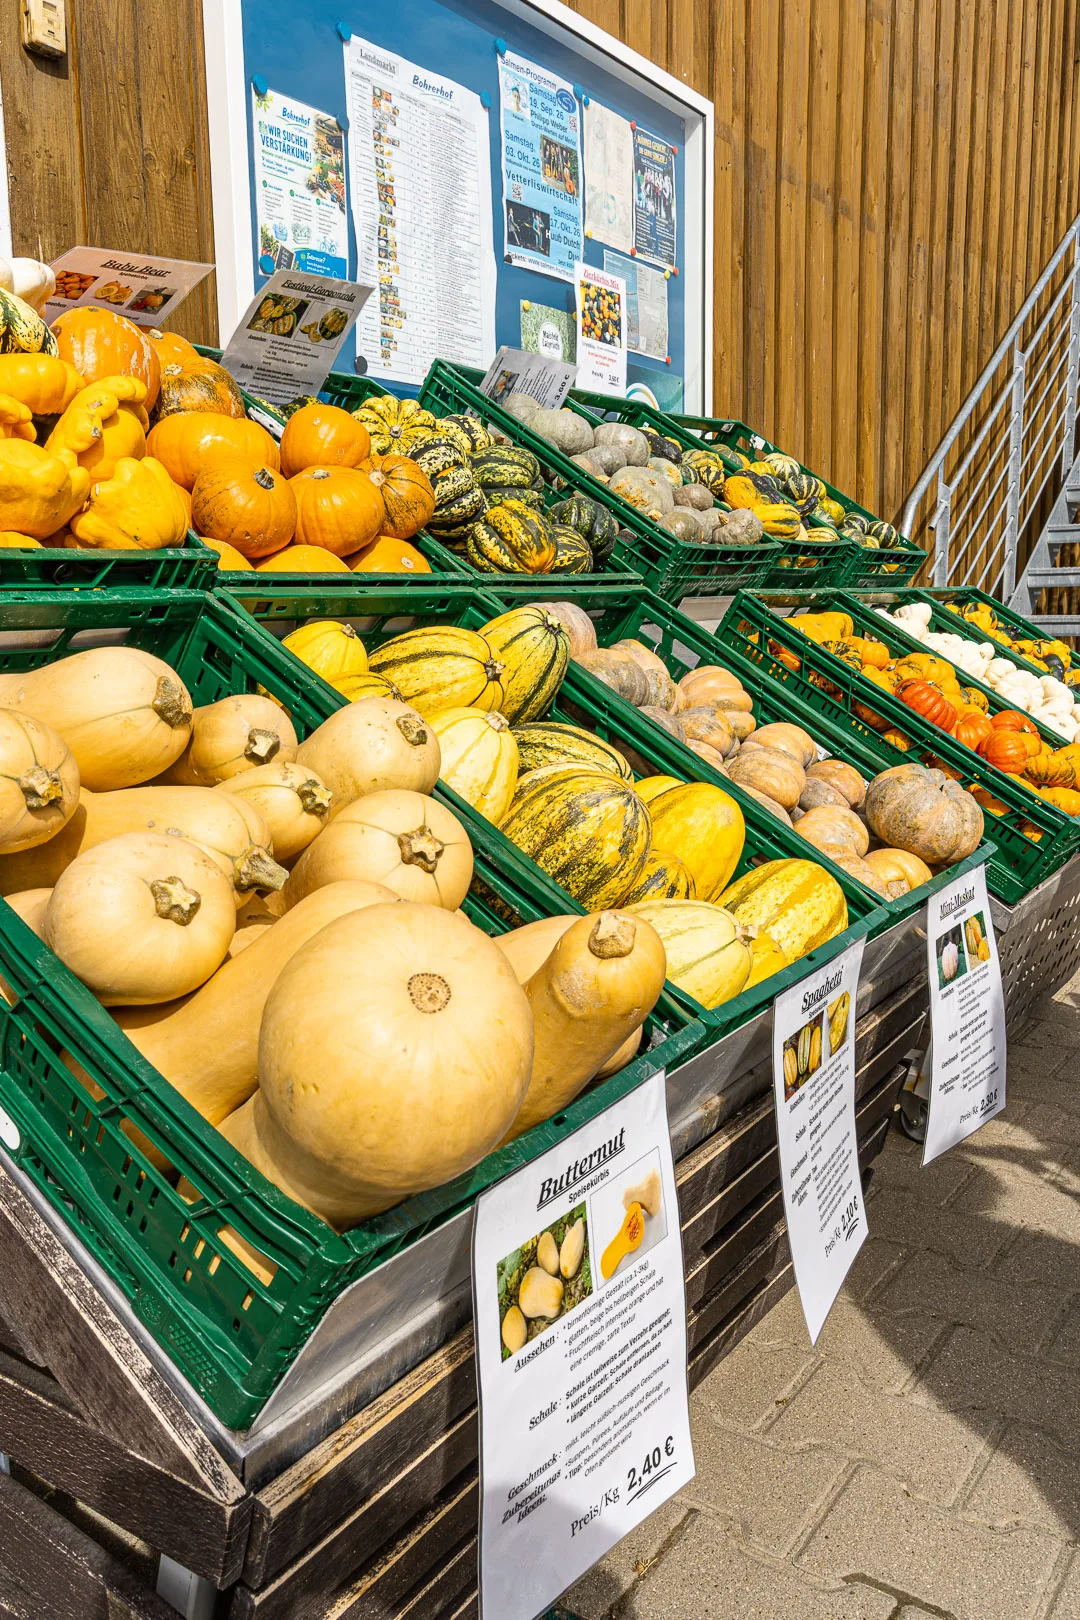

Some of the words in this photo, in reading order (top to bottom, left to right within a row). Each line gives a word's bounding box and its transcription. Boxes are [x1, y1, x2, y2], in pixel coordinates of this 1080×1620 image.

[360, 48, 396, 74] Landmarkt
[501, 56, 556, 91] Salmen-Programm
[412, 75, 453, 100] Bohrerhof
[282, 108, 310, 126] Bohrerhof
[530, 96, 539, 108] 19.
[541, 102, 554, 116] Sep.
[556, 110, 564, 120] 26
[530, 110, 550, 125] Philipp
[551, 118, 568, 133] Weber
[261, 134, 312, 163] VERSTÄRKUNG!
[268, 124, 281, 138] WIR
[283, 130, 308, 148] SUCHEN
[505, 130, 535, 152] Samstag,
[505, 146, 516, 158] 03.
[517, 149, 530, 164] Okt.
[532, 156, 540, 168] 26
[506, 169, 578, 206] Vetterliswirtschaft
[550, 218, 559, 229] 17.
[561, 222, 572, 234] Okt.
[574, 227, 580, 237] 26
[553, 206, 579, 226] Samstag,
[546, 229, 562, 242] Huub
[564, 236, 580, 248] Dutch
[100, 259, 138, 273] Baby
[139, 265, 171, 277] Bear
[281, 280, 356, 302] Festival-Gorgonzola
[610, 280, 620, 291] Mix
[555, 382, 566, 400] 3,60
[940, 885, 975, 919] Mini-Muskat
[802, 965, 843, 1012] Spaghetti
[980, 1092, 993, 1112] 2,30
[994, 1088, 998, 1100] €
[538, 1127, 625, 1206] Butternut
[569, 1169, 610, 1203] Speisekürbis
[841, 1202, 854, 1232] 2,10
[854, 1196, 858, 1210] €
[568, 1296, 605, 1330] birnenförmige
[605, 1280, 624, 1299] Gestalt
[568, 1324, 589, 1345] glatten,
[590, 1311, 604, 1327] beige
[614, 1284, 639, 1306] hellbeigen
[640, 1269, 656, 1287] Schale
[569, 1325, 604, 1358] Fruchtfleisch
[605, 1306, 628, 1329] intensive
[628, 1292, 645, 1310] orange
[645, 1284, 655, 1296] und
[656, 1276, 664, 1288] hat
[570, 1358, 582, 1371] eine
[583, 1340, 606, 1360] cremige,
[607, 1327, 620, 1341] zarte
[620, 1313, 636, 1329] Textur
[565, 1380, 585, 1399] Schale
[594, 1353, 617, 1376] teilweise
[618, 1342, 629, 1357] zum
[629, 1326, 648, 1347] Verzehr
[570, 1392, 586, 1410] kurze
[588, 1373, 609, 1395] Garzeit:
[610, 1359, 626, 1376] Schale
[650, 1332, 657, 1341] da
[657, 1327, 662, 1336] zu
[663, 1318, 672, 1330] hart
[571, 1400, 592, 1423] längere
[593, 1382, 615, 1404] Garzeit:
[615, 1366, 632, 1384] Schale
[633, 1341, 661, 1368] dranlassen
[580, 1421, 596, 1439] leicht
[641, 1359, 670, 1387] Geschmack
[613, 1406, 634, 1427] Aufläufe
[635, 1396, 644, 1409] und
[645, 1381, 663, 1400] Beilage
[584, 1436, 613, 1464] besonders
[643, 1398, 658, 1412] wenn
[664, 1386, 670, 1396] im
[584, 1461, 598, 1477] Ofen
[599, 1442, 620, 1466] geröstet
[621, 1431, 632, 1445] wird
[627, 1446, 661, 1491] 2,40
[664, 1435, 674, 1456] €
[571, 1487, 620, 1537] Preis/Kg
